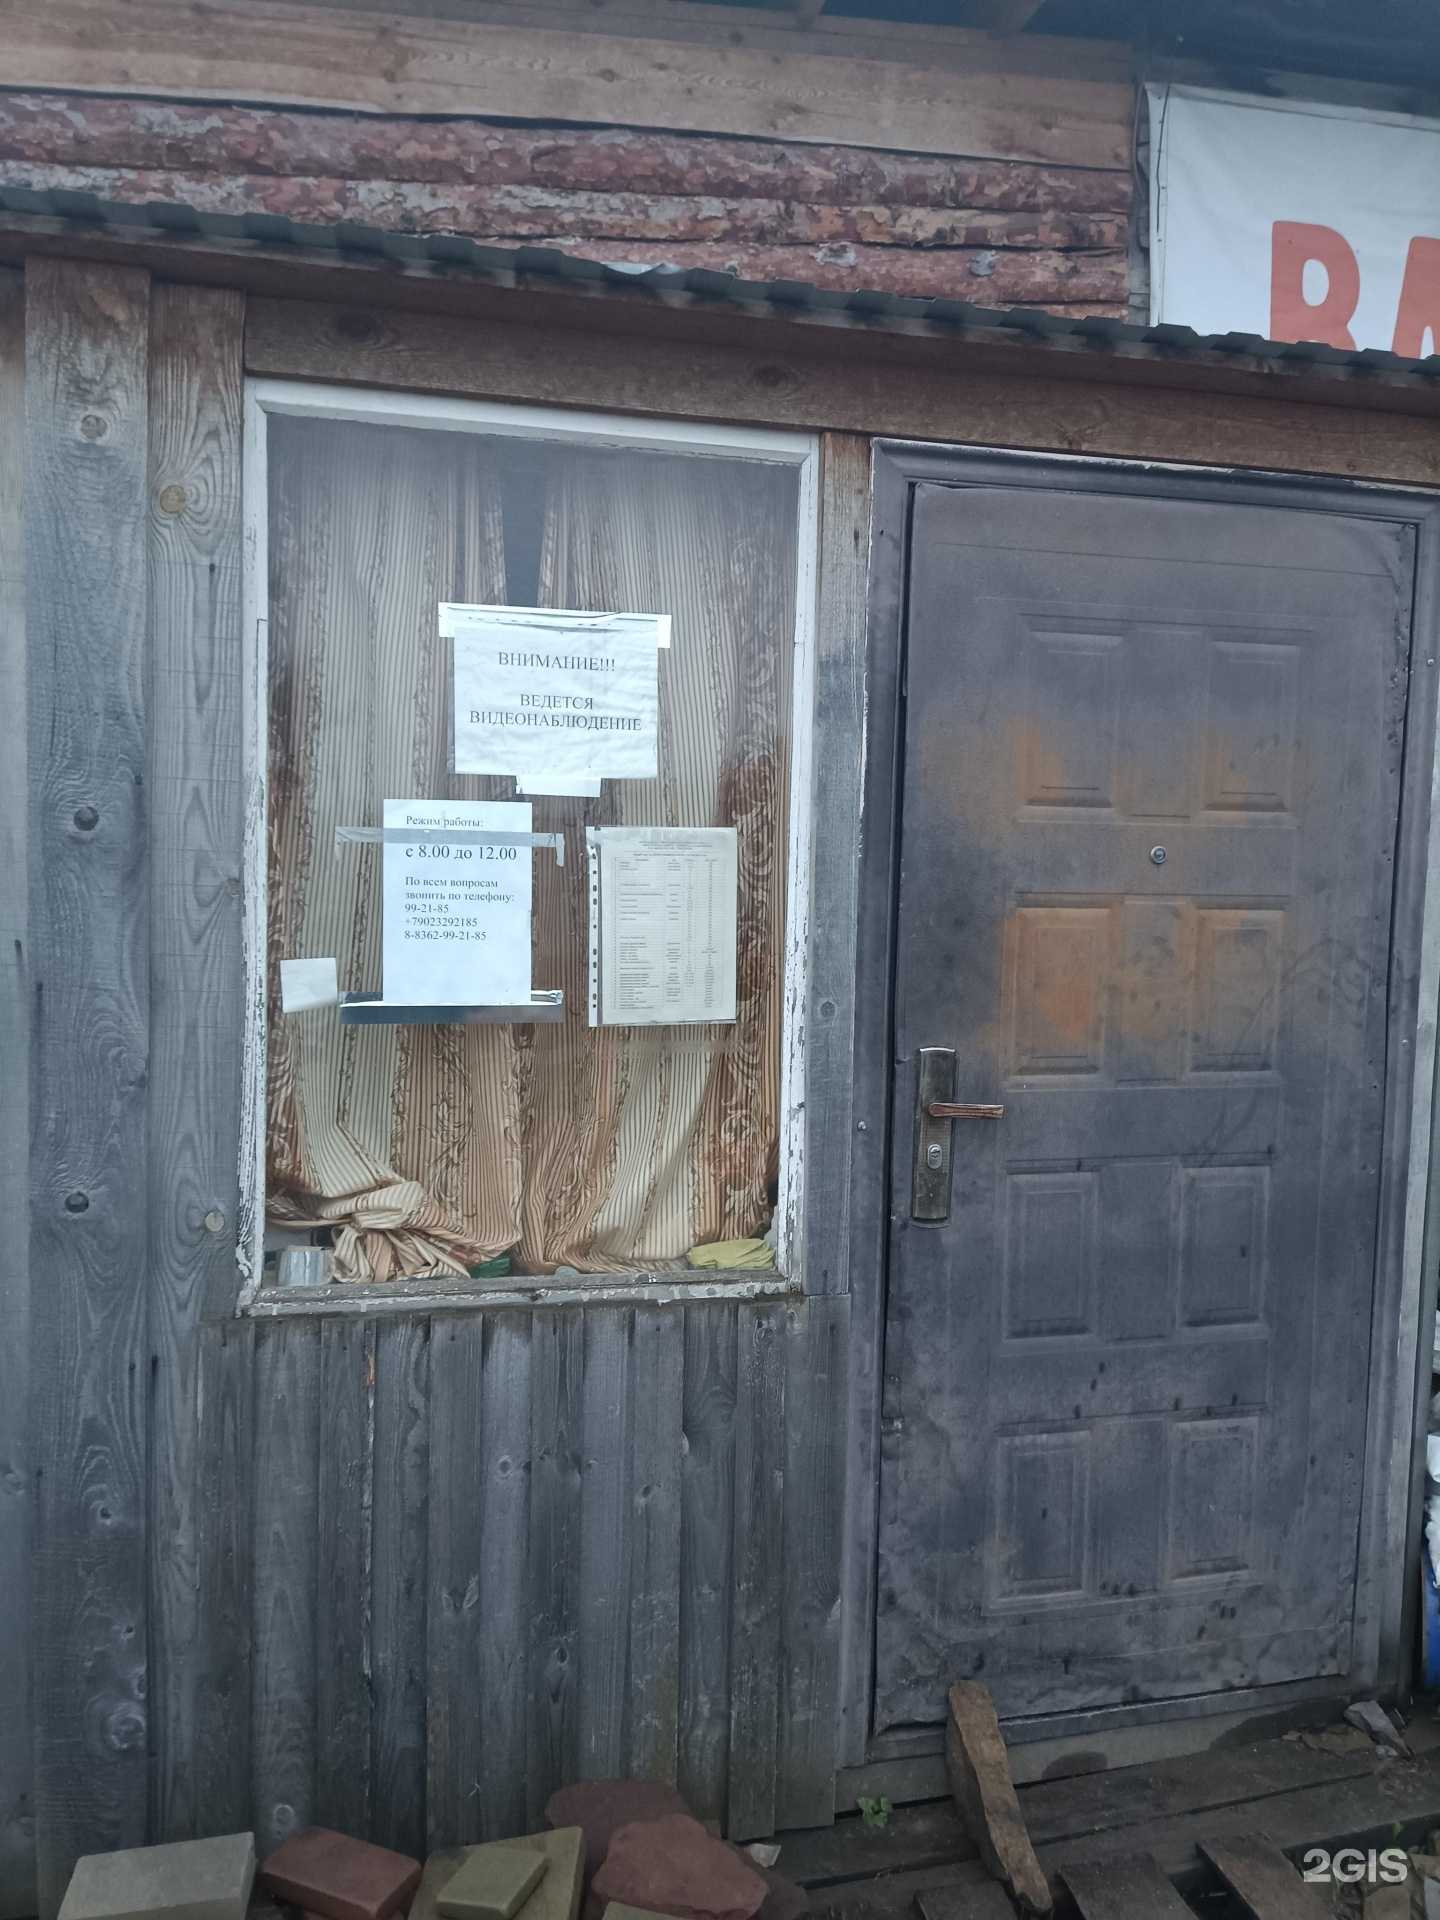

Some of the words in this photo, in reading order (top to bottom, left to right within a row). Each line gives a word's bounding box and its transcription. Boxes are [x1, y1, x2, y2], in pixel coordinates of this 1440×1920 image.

[498, 651, 616, 672] ВНИМАНИЕ!!!
[519, 693, 593, 710] ВЕДЕТСЯ
[469, 710, 642, 732] ВИДЕОНАБЛЮДЕНИЕ
[406, 815, 440, 826] Режим
[443, 815, 483, 828] работы:
[405, 848, 413, 857] с
[418, 845, 450, 859] 8.00
[454, 849, 473, 860] до
[479, 846, 517, 861] 12.00
[405, 876, 420, 887] По
[423, 880, 447, 888] всем
[450, 880, 498, 889] вопросам
[405, 891, 445, 900] звонить
[448, 893, 461, 901] по
[404, 903, 449, 913] 99-21-85
[404, 917, 478, 928] +79023292185
[404, 930, 487, 941] 8-8362-99-21-85
